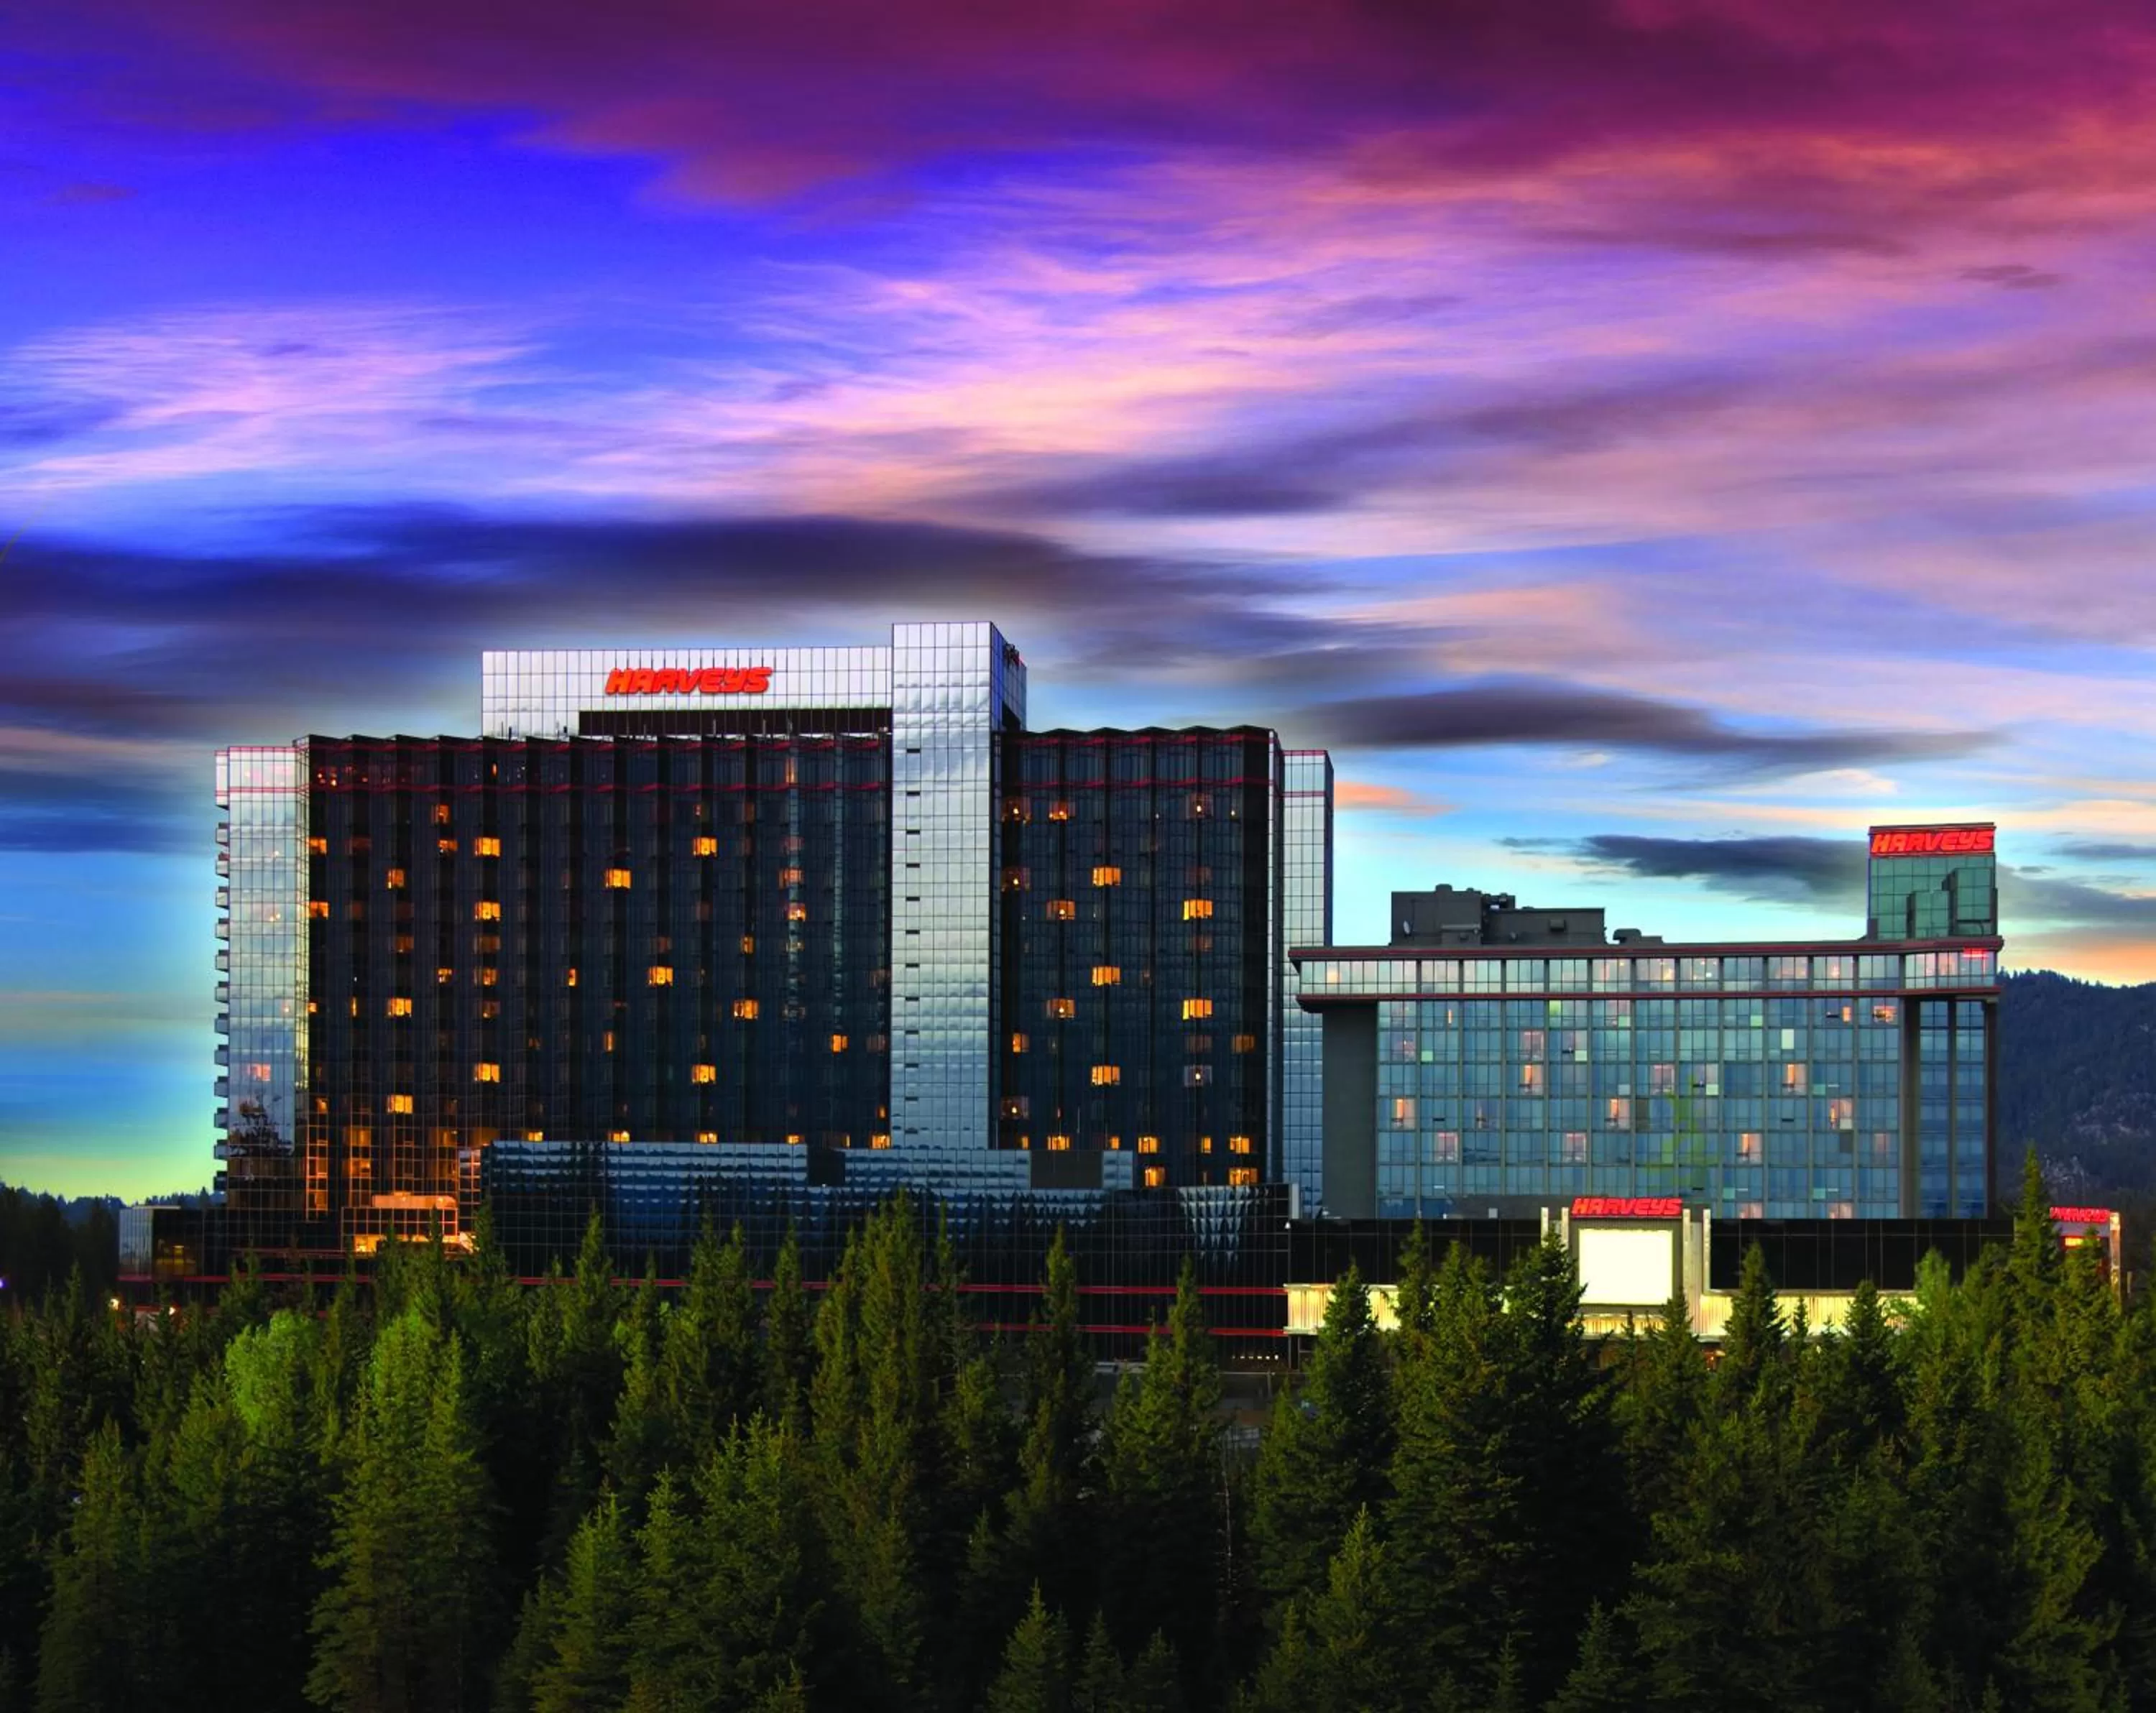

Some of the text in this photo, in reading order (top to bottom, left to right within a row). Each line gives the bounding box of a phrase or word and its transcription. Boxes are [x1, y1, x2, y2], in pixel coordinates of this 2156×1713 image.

[605, 667, 773, 695] HARVEYS
[1871, 830, 1994, 853] HARVEYS
[1572, 1197, 1683, 1216] HARVEYS
